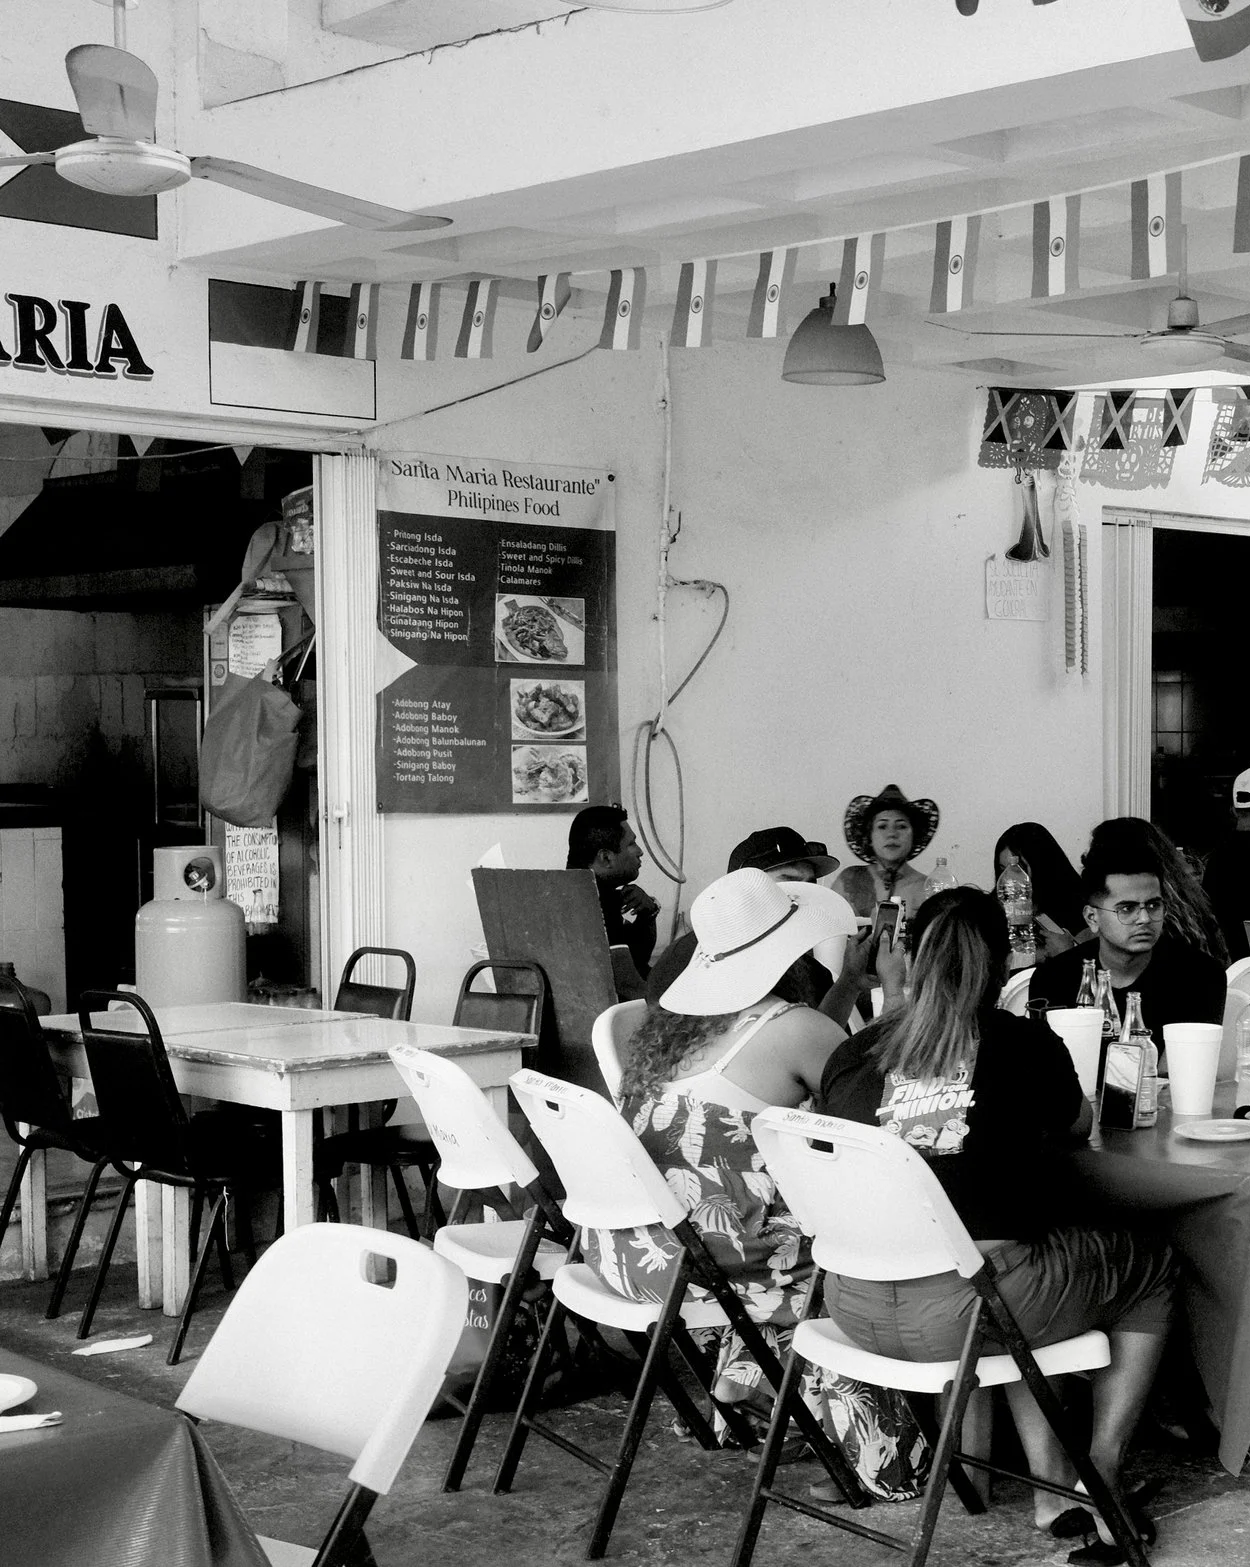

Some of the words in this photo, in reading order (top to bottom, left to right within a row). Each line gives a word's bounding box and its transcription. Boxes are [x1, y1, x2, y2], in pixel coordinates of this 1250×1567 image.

[0, 293, 154, 381] RIA
[447, 464, 498, 486] Maria
[448, 490, 520, 514] Philipines
[524, 497, 560, 516] Food
[394, 529, 421, 542] Pritong
[424, 533, 442, 542] Isda
[438, 546, 456, 555] Isda
[435, 559, 453, 567] Isda
[529, 554, 543, 562] and
[546, 555, 565, 565] Spicy
[528, 565, 552, 574] Manok
[418, 570, 432, 578] and
[435, 571, 454, 580] Sour
[458, 572, 475, 581] Isda
[422, 582, 432, 590] Na
[435, 583, 452, 592] Isda
[430, 594, 440, 603] Na
[442, 596, 459, 604] Isda
[428, 607, 438, 615] Na
[441, 608, 463, 618] Hipon
[435, 620, 459, 629] Hipon
[430, 631, 441, 639] Na
[444, 632, 468, 642] Hipon
[432, 700, 451, 710] Atay
[432, 712, 457, 723] Baboy
[432, 725, 459, 733] Manok
[432, 737, 486, 746] Balunbalunan
[433, 749, 453, 758] Pusit
[432, 761, 456, 772] Baboy
[428, 773, 454, 784] Talong
[227, 835, 240, 848] THE
[227, 852, 234, 864] OF
[270, 863, 276, 875] IS
[228, 893, 244, 902] THIS
[888, 1076, 945, 1106] FIND
